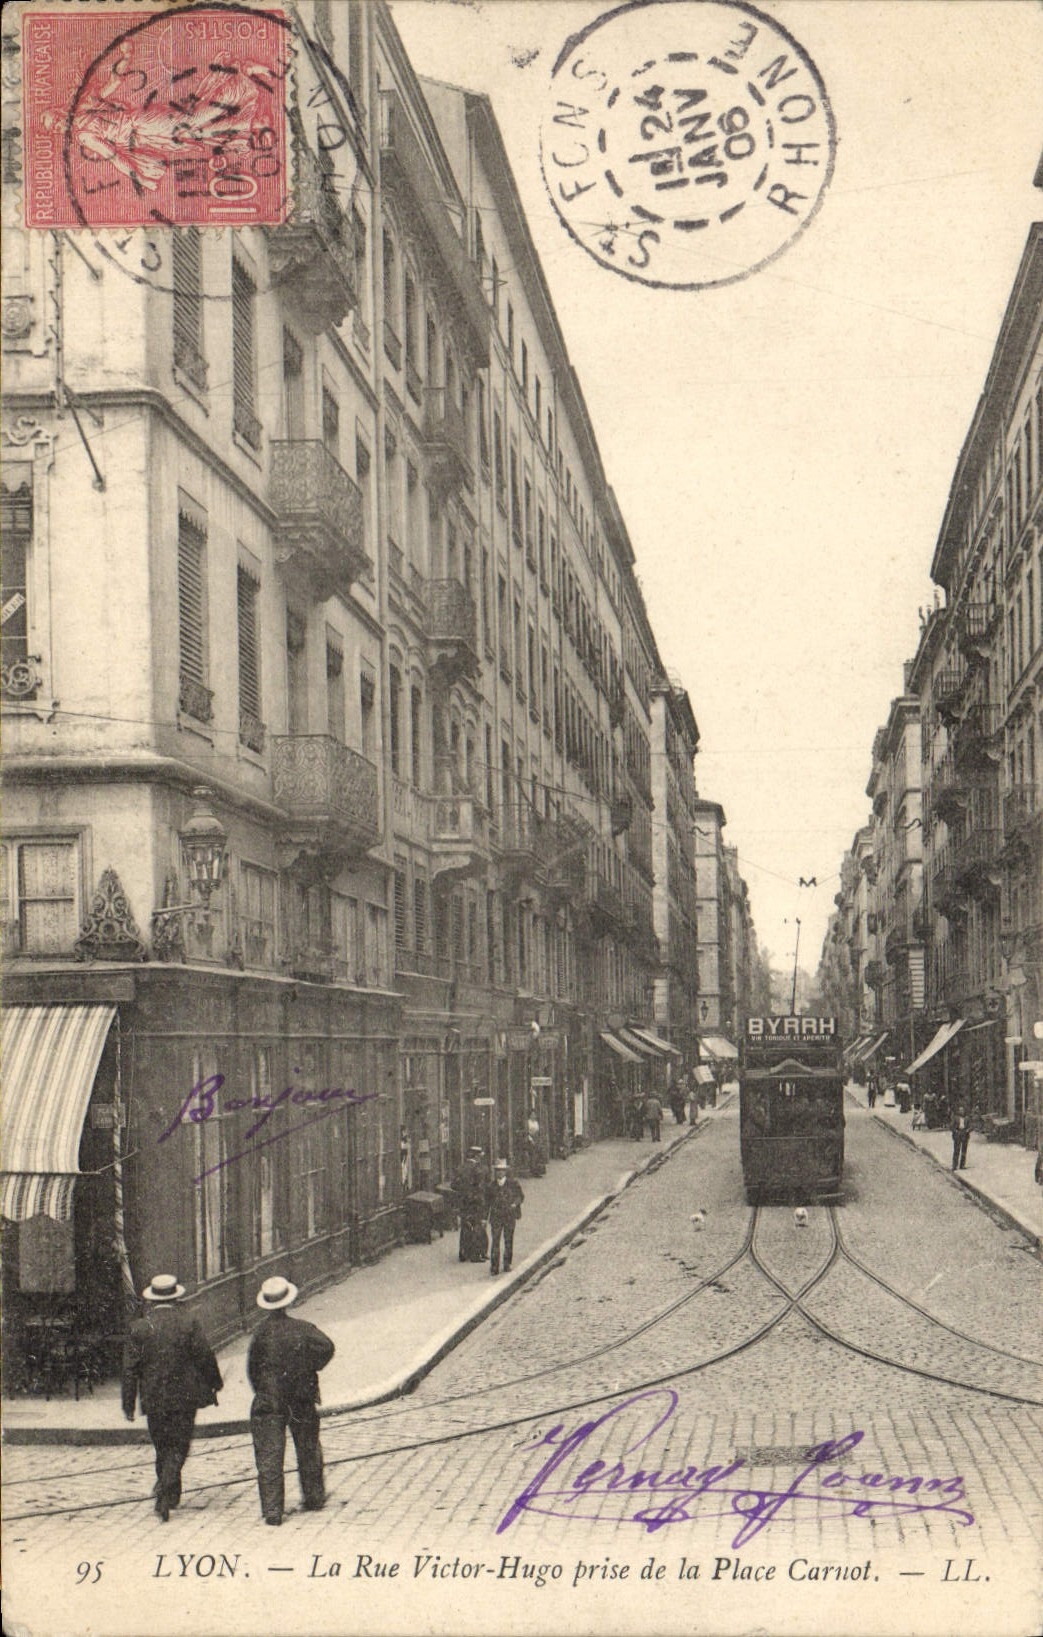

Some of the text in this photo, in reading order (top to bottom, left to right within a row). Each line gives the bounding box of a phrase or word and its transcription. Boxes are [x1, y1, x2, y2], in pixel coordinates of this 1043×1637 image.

[185, 20, 268, 41] POSTES
[633, 84, 673, 141] 24
[673, 88, 729, 188] JANV
[716, 105, 756, 161] 06
[724, 21, 820, 216] RHONE
[748, 1017, 835, 1034] BYRRH
